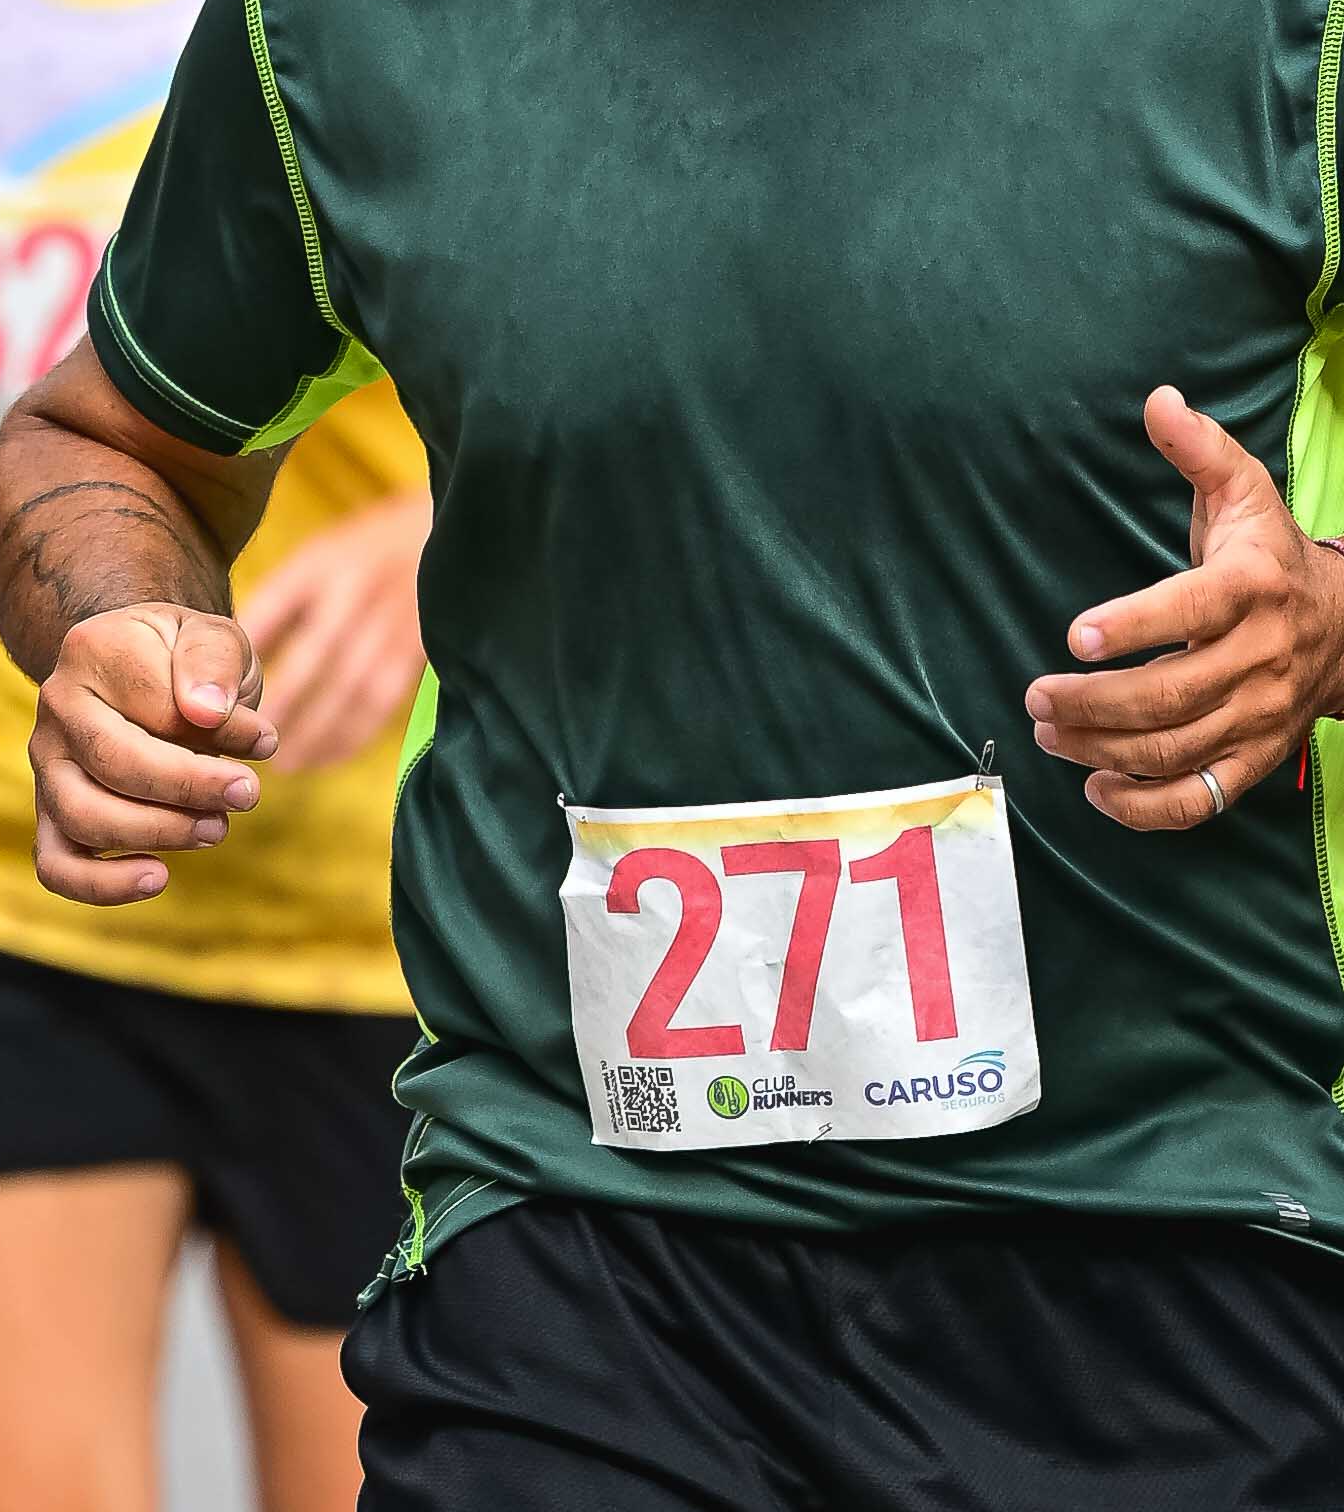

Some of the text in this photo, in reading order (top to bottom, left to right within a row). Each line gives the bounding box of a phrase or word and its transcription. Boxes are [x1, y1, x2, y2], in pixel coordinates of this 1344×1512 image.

[606, 825, 959, 1059] 271
[752, 1075, 796, 1093] CLUB
[865, 1068, 1004, 1107] CARUSO
[753, 1090, 833, 1111] RUNNER'S
[941, 1093, 1005, 1112] SEGUROS
